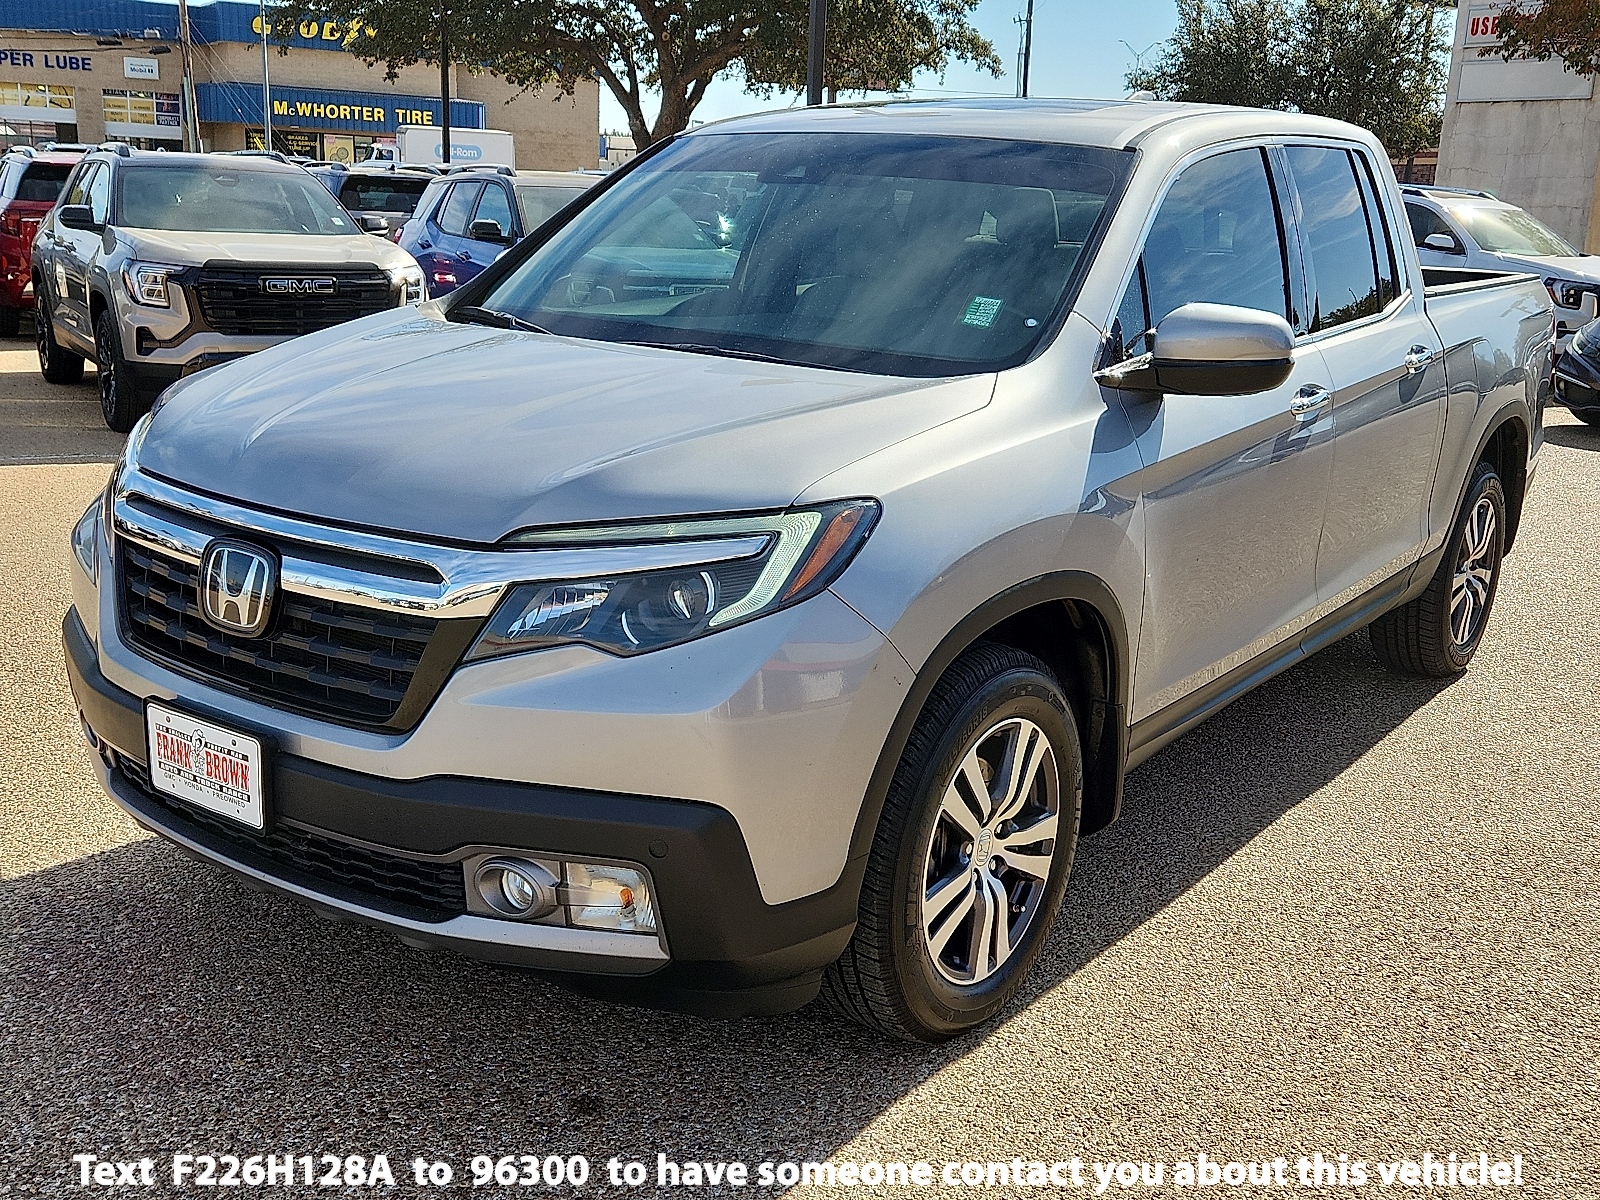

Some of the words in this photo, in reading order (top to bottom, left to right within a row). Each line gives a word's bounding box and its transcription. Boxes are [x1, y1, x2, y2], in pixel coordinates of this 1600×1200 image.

[44, 54, 92, 71] LUBE
[273, 100, 385, 122] McWHORTER
[395, 109, 433, 125] TIRE
[266, 280, 334, 293] GMC
[156, 731, 192, 772] FRANK
[205, 750, 249, 793] BROWN
[160, 761, 178, 774] AUTO
[180, 769, 194, 780] AND
[195, 776, 220, 791] TRUCK
[223, 786, 249, 801] RANCH
[164, 772, 176, 782] GMC
[184, 780, 203, 793] HONDA
[212, 790, 246, 808] PREOWNED
